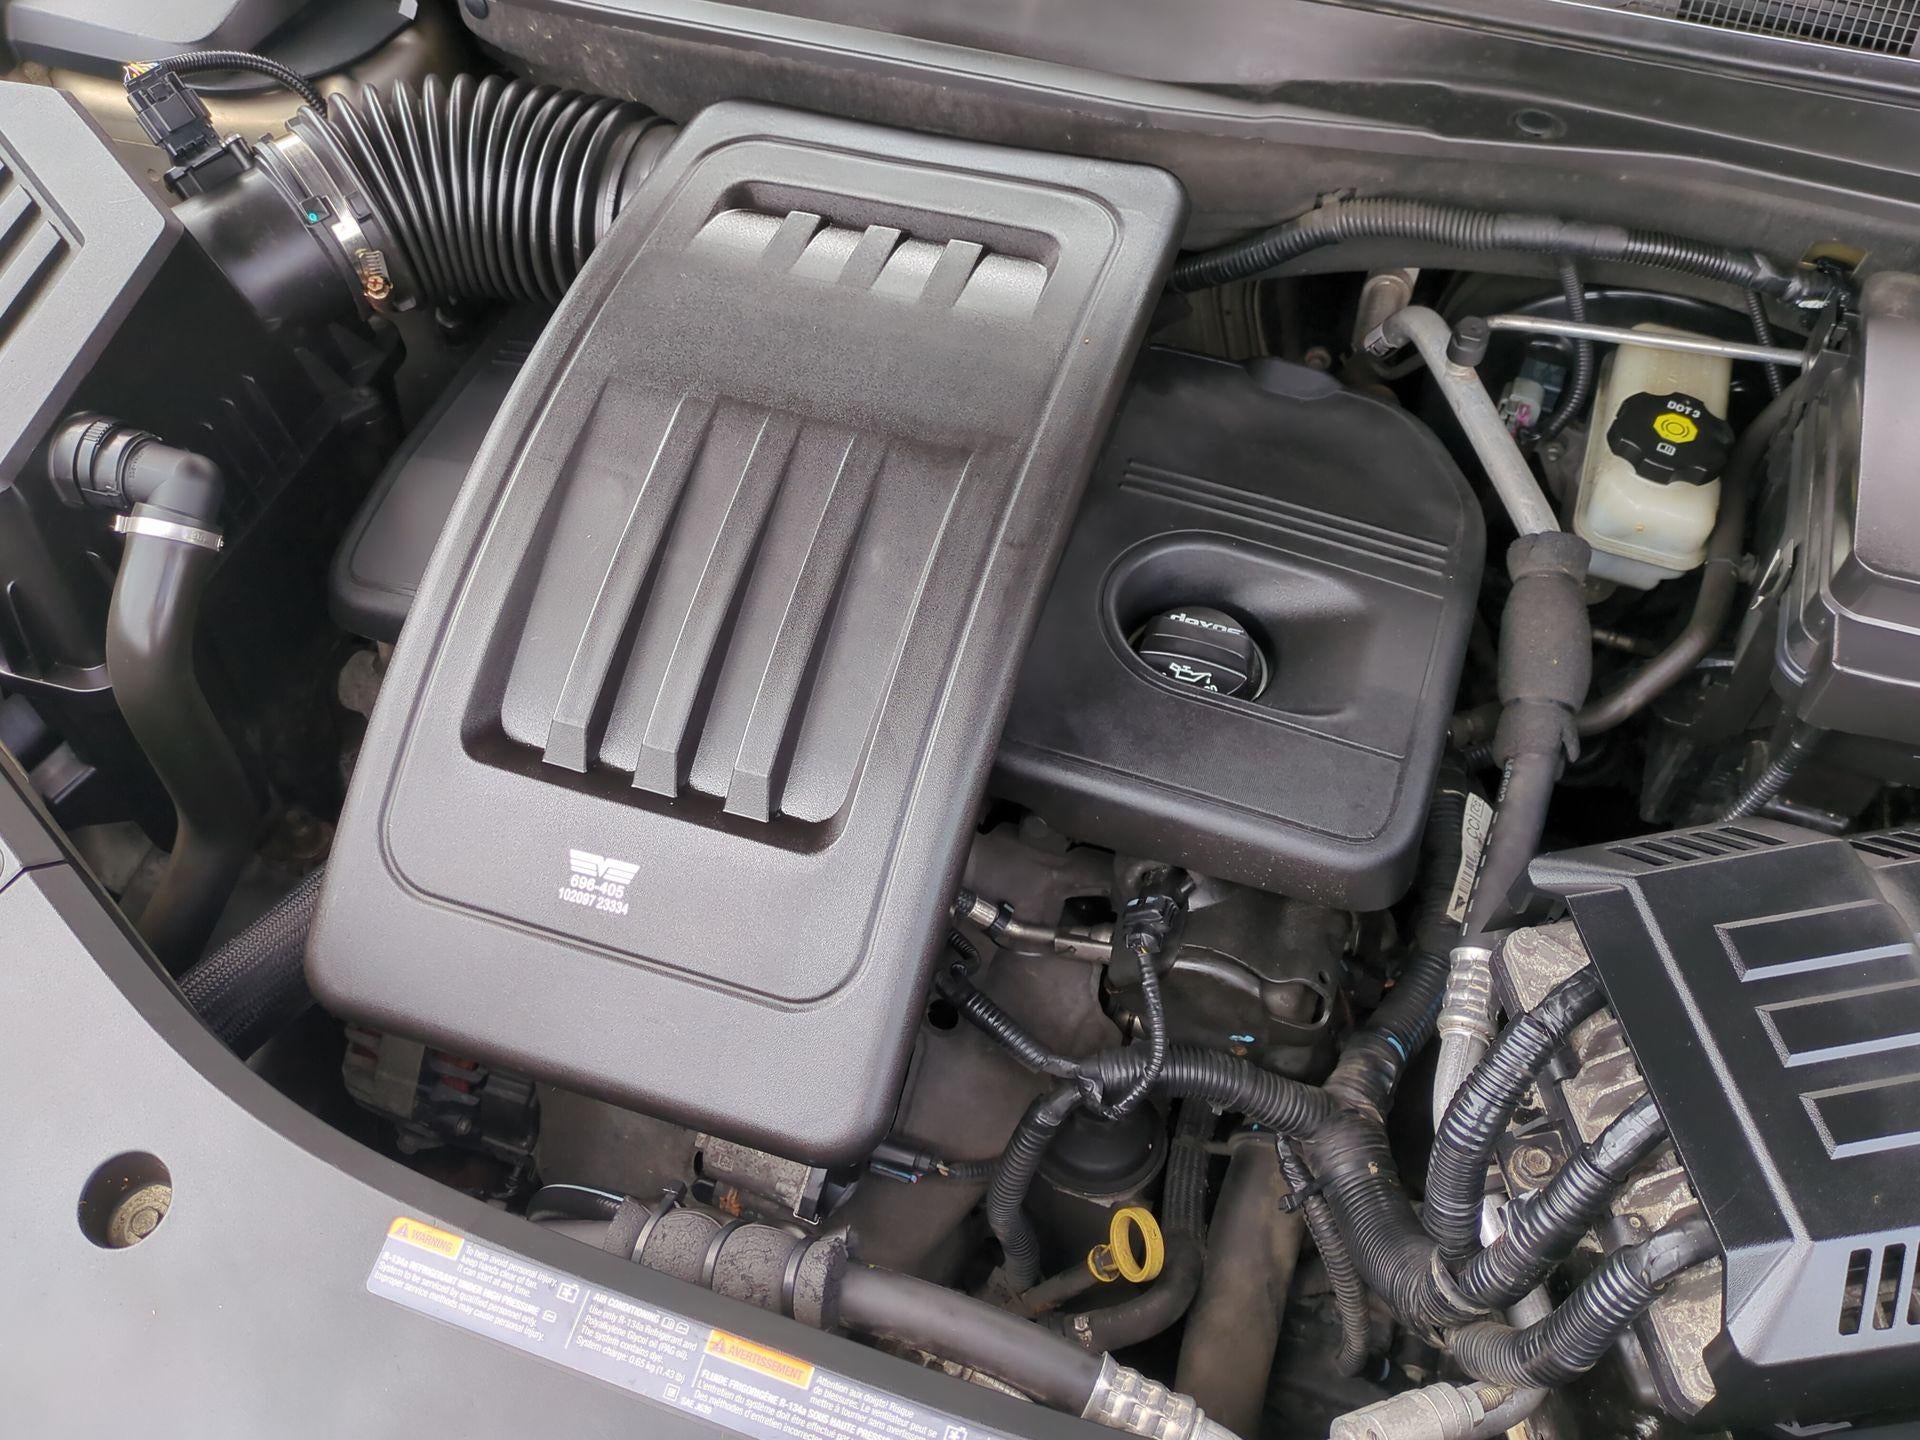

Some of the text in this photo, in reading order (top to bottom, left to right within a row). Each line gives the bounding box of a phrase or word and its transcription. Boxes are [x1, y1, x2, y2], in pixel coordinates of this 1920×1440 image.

[1667, 400, 1693, 414] DOT
[558, 887, 629, 915] 102097 23334
[570, 874, 625, 899] 696-405
[411, 1228, 453, 1252] WARNING
[460, 1254, 478, 1268] keep
[516, 1275, 525, 1285] of
[462, 1267, 476, 1277] can
[475, 1271, 492, 1283] start
[499, 1282, 513, 1292] any
[465, 1245, 474, 1254] To
[473, 1248, 489, 1261] help
[489, 1254, 508, 1267] avoid
[507, 1262, 537, 1279] personal
[373, 1271, 404, 1289] Improper
[403, 1283, 429, 1297] service
[428, 1292, 458, 1309] methods
[457, 1303, 472, 1315] may
[472, 1309, 494, 1322] cause
[493, 1316, 523, 1334] personal
[378, 1261, 404, 1277] System
[411, 1273, 421, 1283] be
[420, 1277, 450, 1294] serviced
[449, 1287, 460, 1298] by
[458, 1291, 488, 1309] qualified
[486, 1302, 521, 1322] personnel
[382, 1250, 539, 1316] R-134a REFRIGERANT UNDER HIGH PRESSURE
[593, 1292, 660, 1323] AIR CONDITIONING
[580, 1325, 665, 1364] The system contains dye.
[584, 1315, 627, 1338] Polyalkylene
[626, 1330, 648, 1346] Glycol
[647, 1338, 659, 1348] oil
[657, 1341, 676, 1355] (PAG
[588, 1304, 697, 1351] Use only R-134a Refrigerant and
[575, 1335, 602, 1352] System
[601, 1344, 629, 1363] charge:
[628, 1354, 646, 1368] 0.65
[644, 1360, 657, 1373] kg
[655, 1365, 675, 1380] (1.43
[728, 1345, 804, 1380] AVERTISSEMENT
[693, 1389, 709, 1401] Des
[708, 1394, 744, 1415] méthodes
[743, 1407, 783, 1429] d'entretien
[696, 1378, 735, 1400] L'entretien
[734, 1392, 745, 1403] du
[744, 1397, 776, 1417] système
[775, 1408, 790, 1421] doit
[789, 1413, 806, 1427] être
[805, 1420, 837, 1438] effectué
[701, 1369, 729, 1386] FLUIDE
[778, 1398, 807, 1415] R-134a
[806, 1408, 830, 1424] SOUS
[828, 1416, 856, 1433] HAUTE
[809, 1395, 834, 1410] mettre
[840, 1407, 866, 1422] tourner
[867, 1417, 886, 1429] sans
[812, 1385, 937, 1438] de blessures. Le ventilateur peut se
[815, 1375, 914, 1419] Attention aux doigts! Risque
